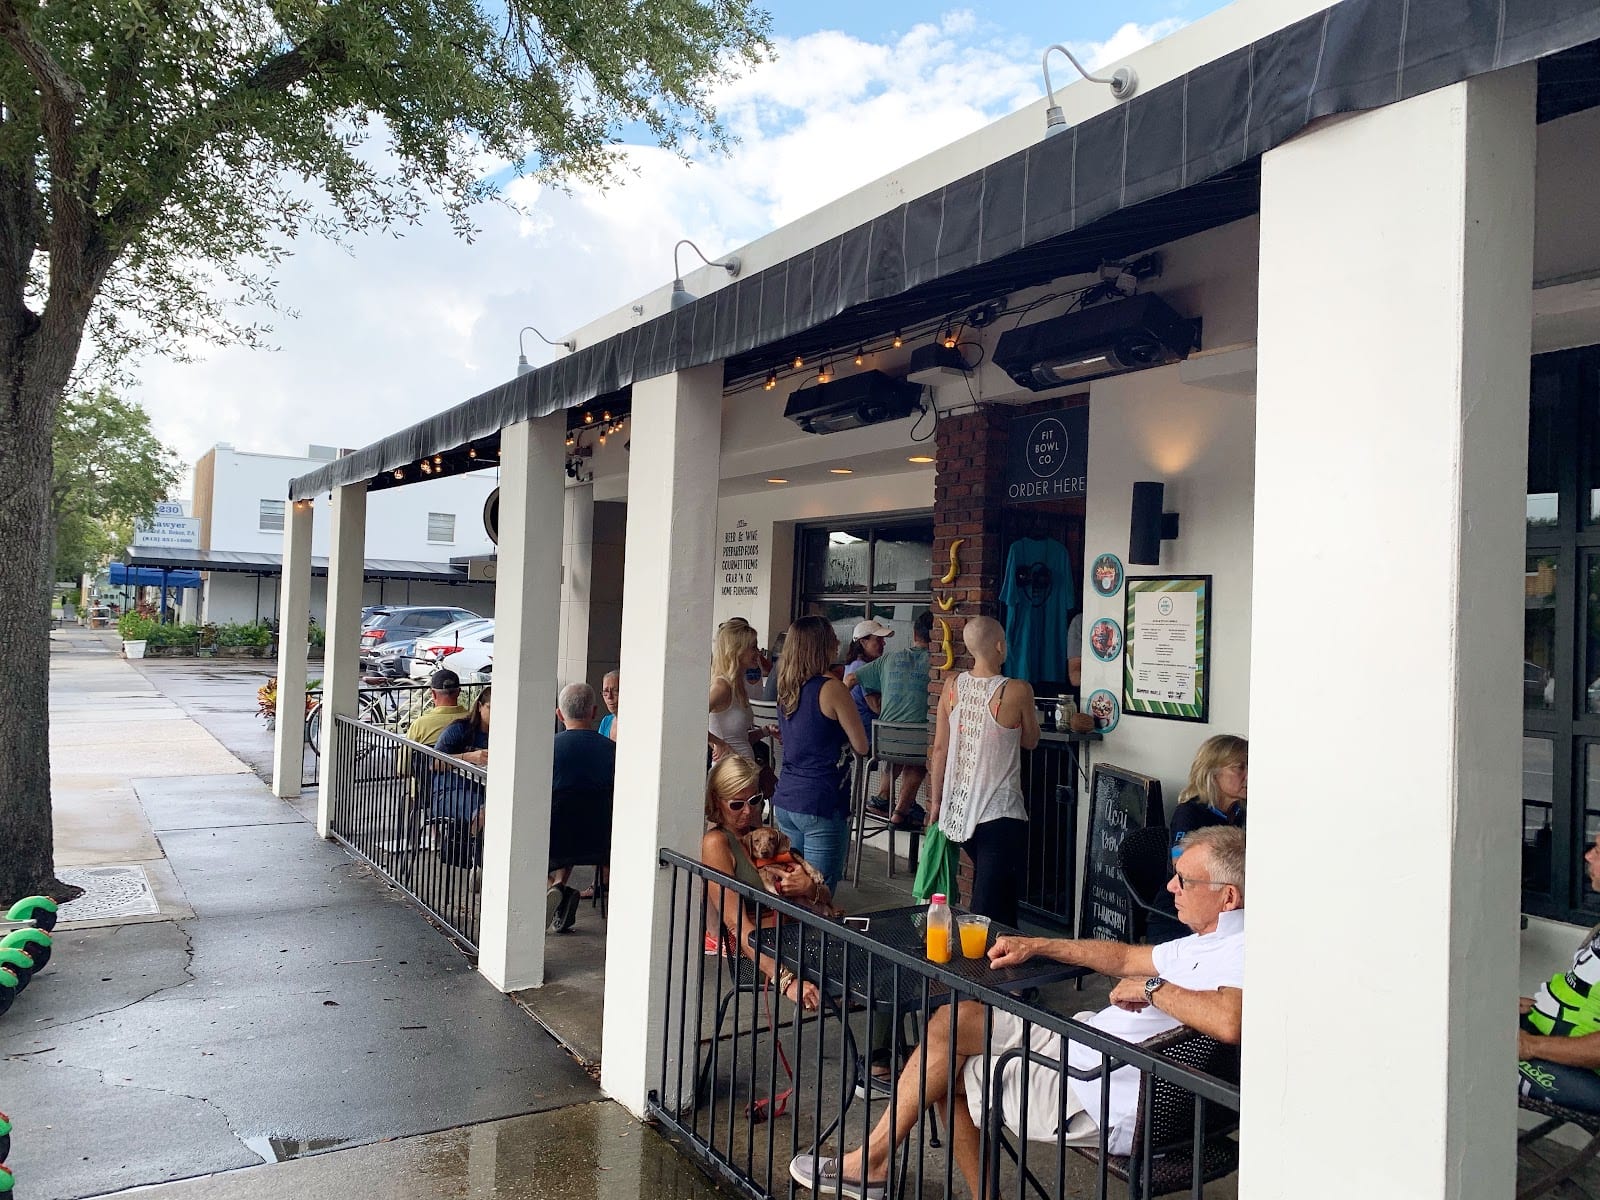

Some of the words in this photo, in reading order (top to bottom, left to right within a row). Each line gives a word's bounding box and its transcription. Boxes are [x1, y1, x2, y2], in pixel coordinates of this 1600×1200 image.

[1041, 430, 1054, 440] FIT
[1035, 441, 1060, 453] BOWL
[1038, 454, 1054, 465] CO.
[1008, 480, 1049, 498] ORDER
[1053, 476, 1086, 493] HERE
[725, 531, 736, 544] BEER
[738, 531, 744, 542] &
[745, 529, 758, 541] WINE
[722, 545, 744, 558] PREPARED
[744, 544, 759, 556] FOODS
[721, 559, 743, 570] GOURMET
[743, 558, 758, 570] ITEMS
[721, 586, 732, 596] HOME
[733, 586, 758, 596] FURNISHINGS
[1093, 902, 1127, 935] THURSDAY
